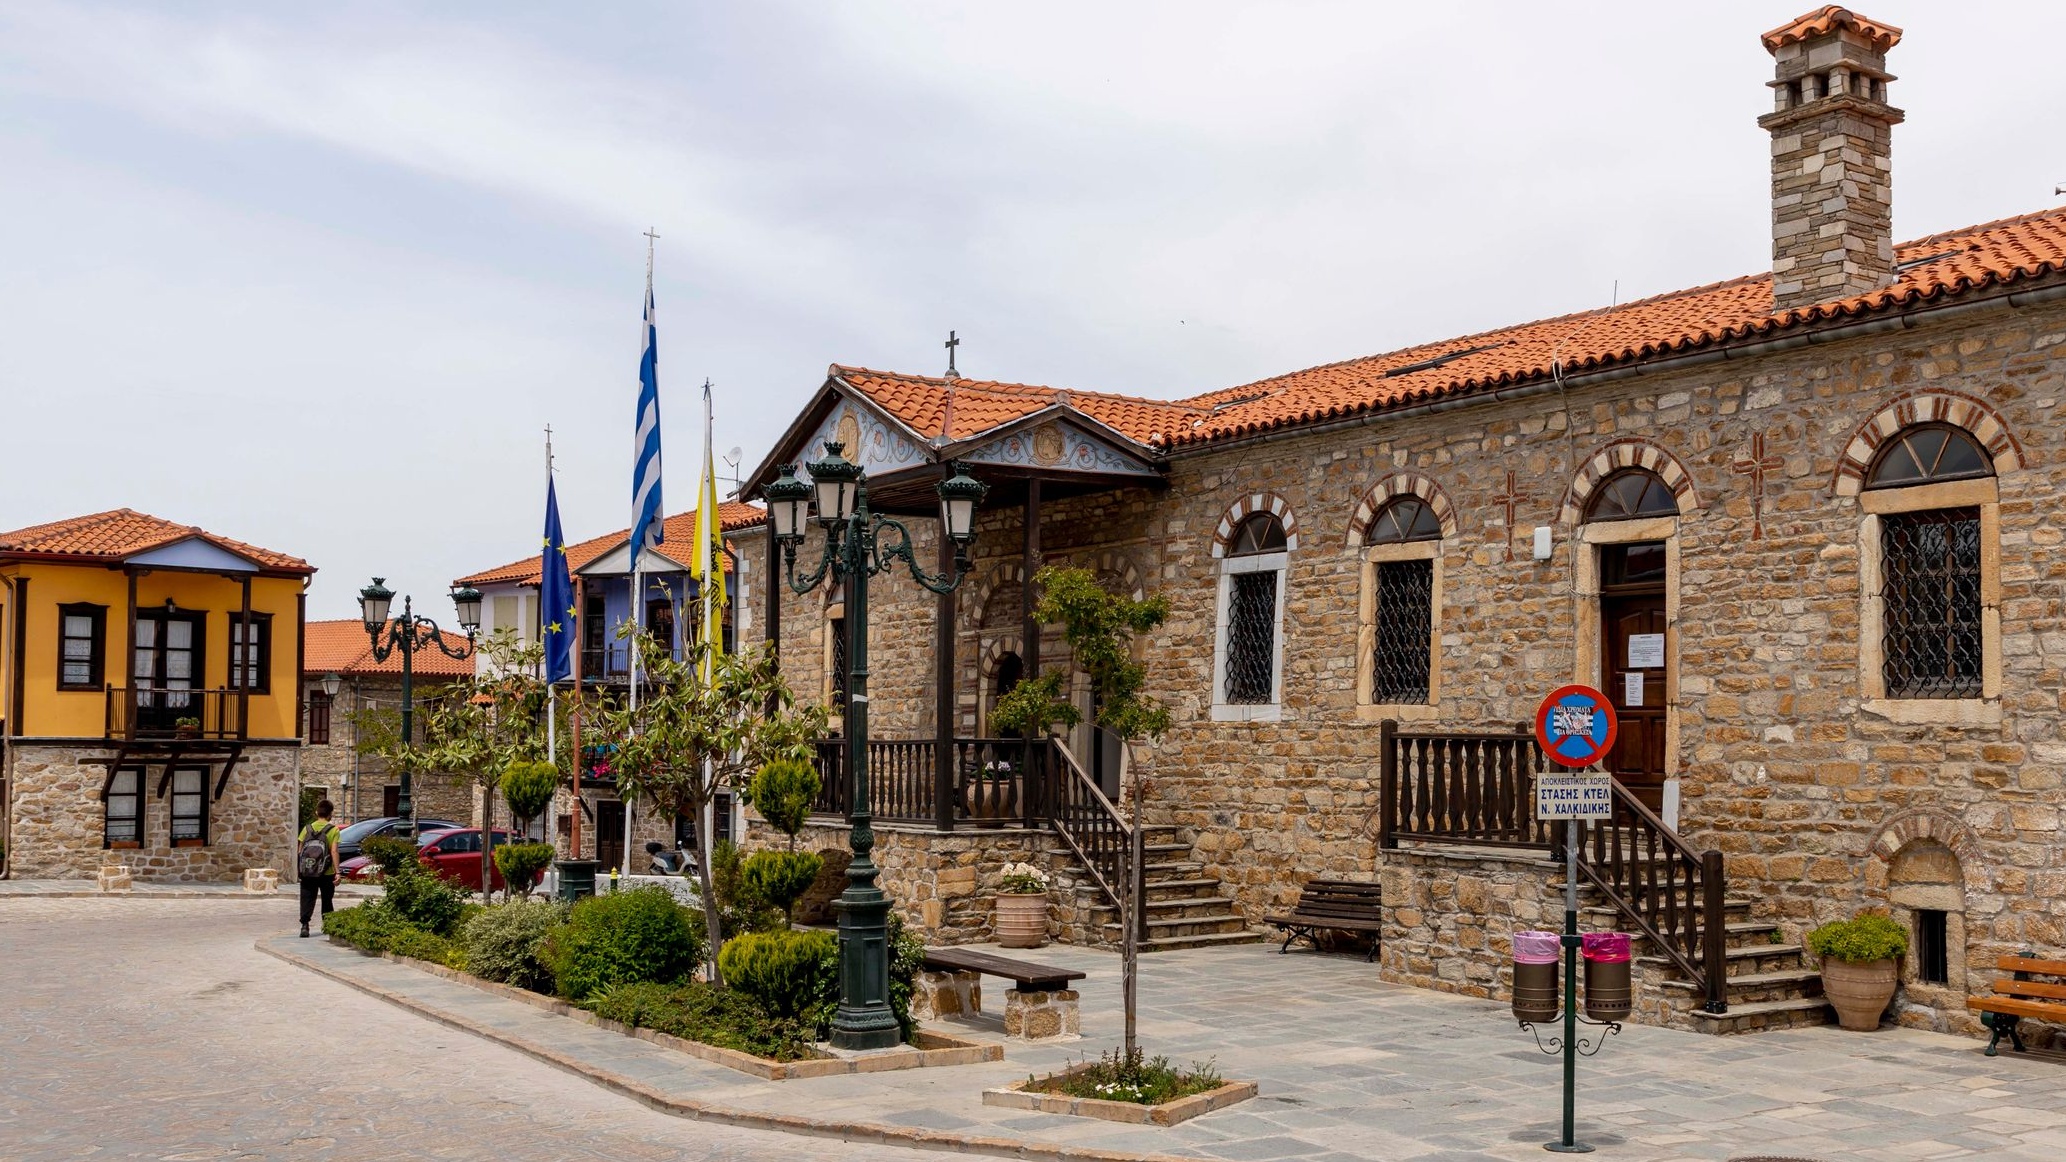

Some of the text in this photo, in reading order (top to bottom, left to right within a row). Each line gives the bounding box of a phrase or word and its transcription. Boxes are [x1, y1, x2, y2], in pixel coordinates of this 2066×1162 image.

[1541, 777, 1610, 786] ΑΠΟΚΛΕΙΣΤΙΚΟΣ ΧΩΡΟΣ
[1541, 788, 1610, 800] ΣΤΑΣΗΣ ΚΤΕΛ
[1541, 803, 1610, 815] Ν. ΧΑΛΚΙΔΙΚΗΣ
